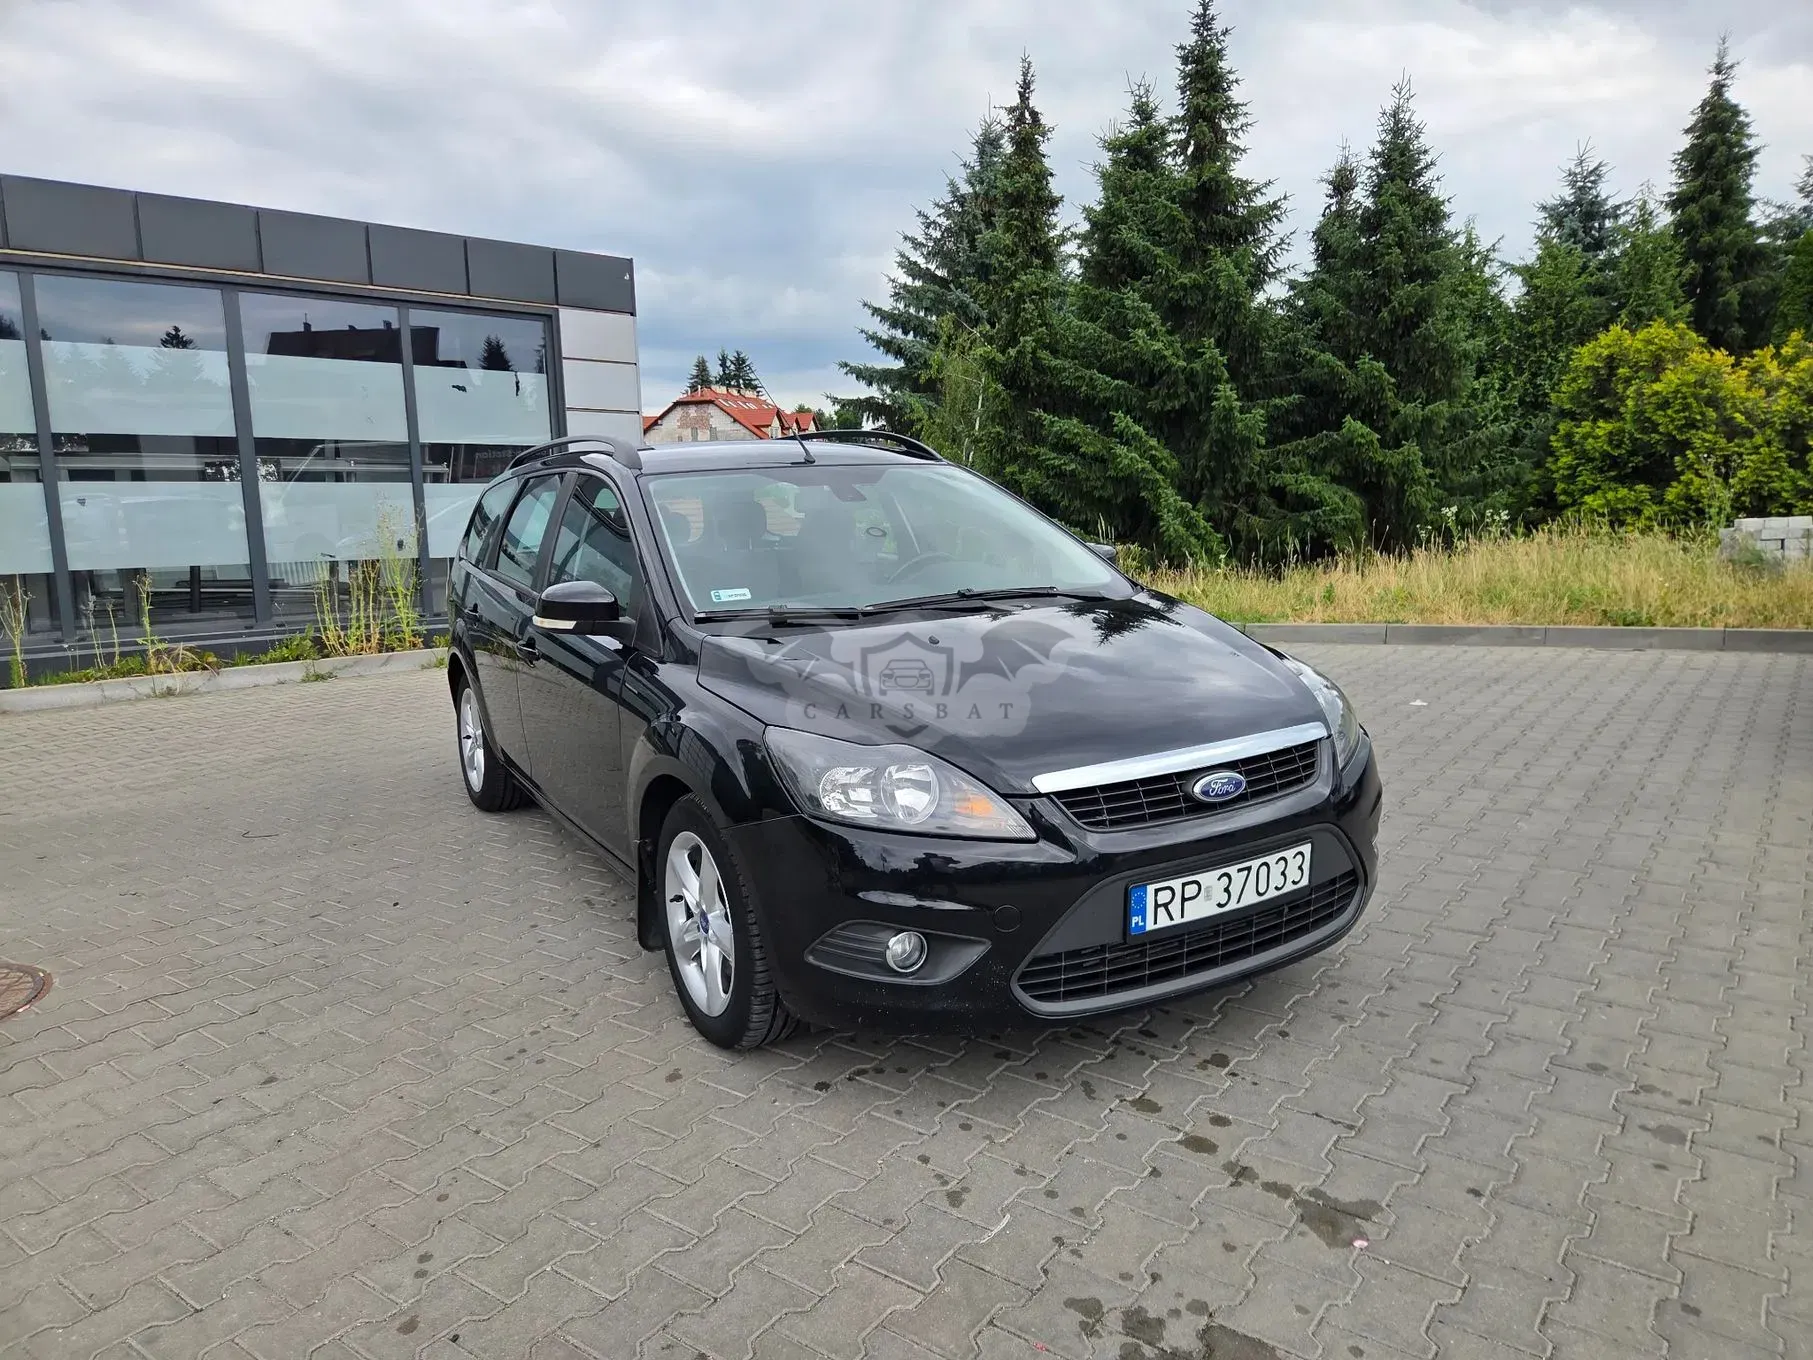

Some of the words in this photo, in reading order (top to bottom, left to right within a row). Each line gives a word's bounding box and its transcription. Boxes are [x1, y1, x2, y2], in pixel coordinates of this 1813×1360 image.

[1209, 778, 1236, 796] Ford
[1153, 880, 1201, 925] RP
[1216, 851, 1306, 909] 37033
[1131, 917, 1144, 927] PL
